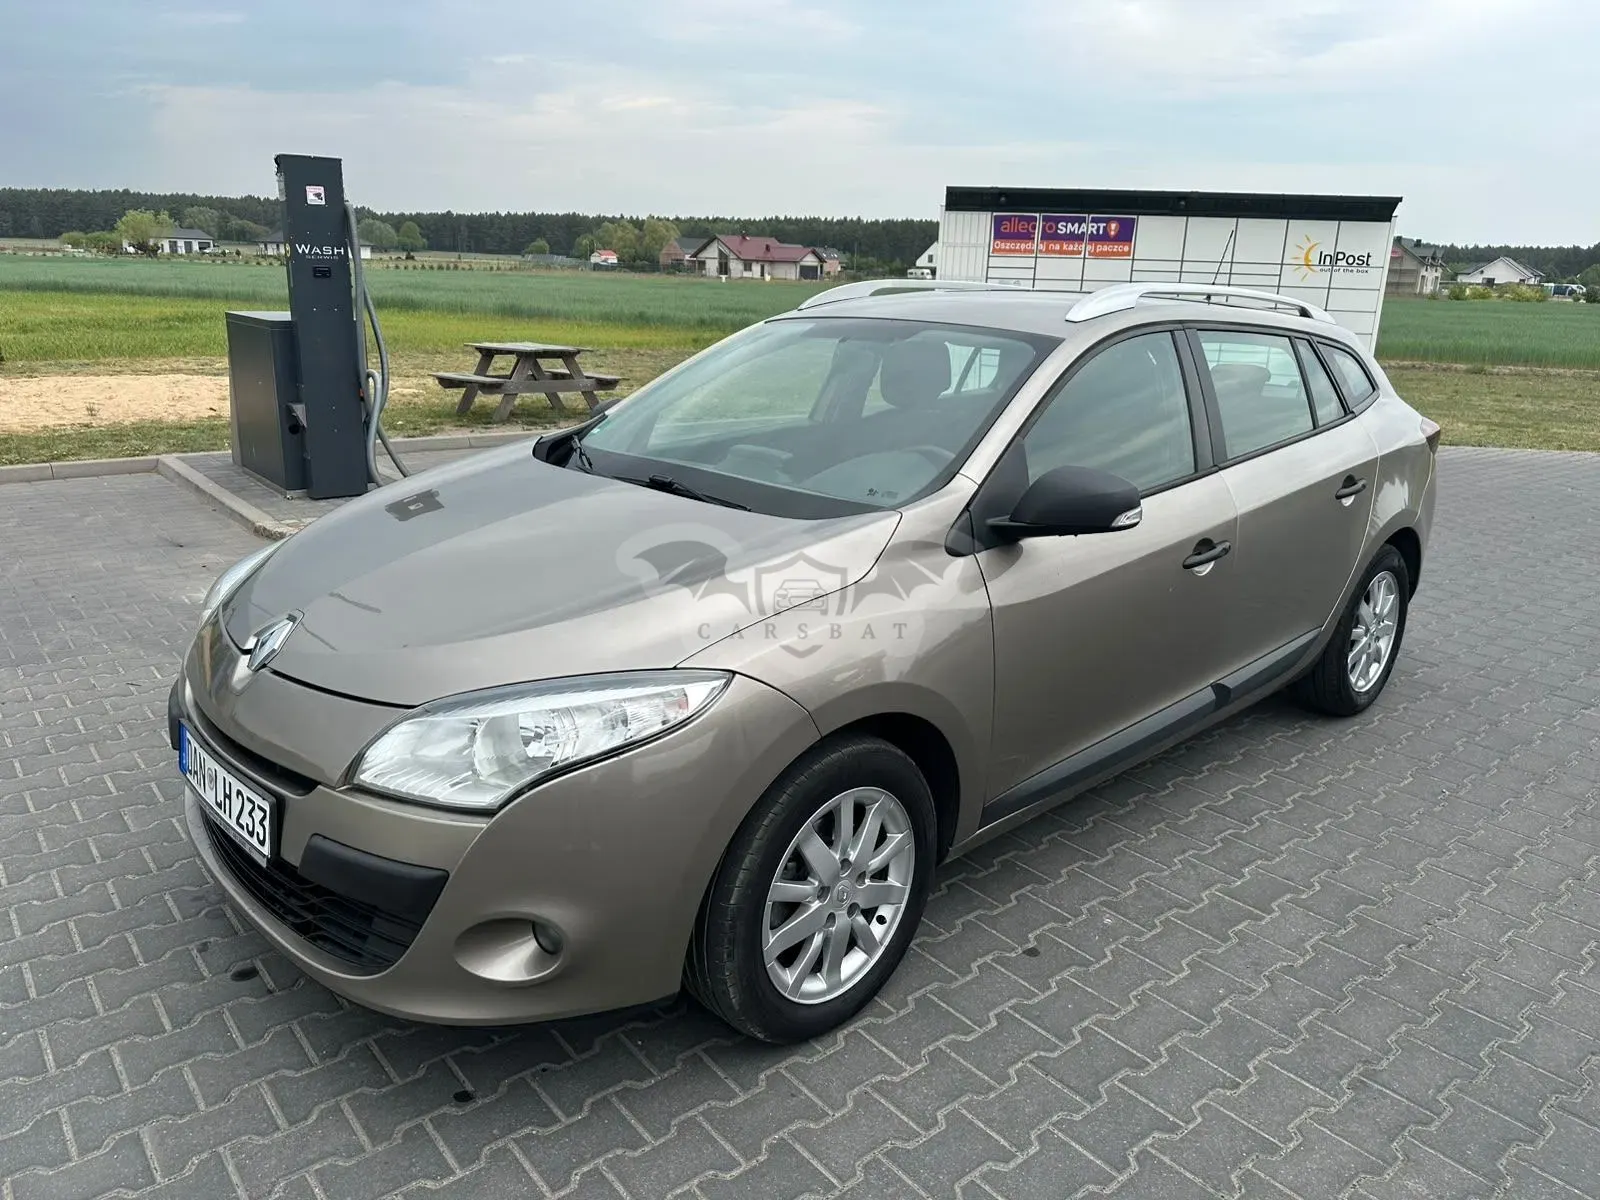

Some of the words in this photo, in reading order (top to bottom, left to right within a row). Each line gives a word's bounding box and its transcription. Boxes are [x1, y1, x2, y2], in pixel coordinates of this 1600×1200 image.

[1057, 221, 1106, 235] SMART
[295, 243, 344, 255] WASH
[1048, 243, 1060, 251] na
[1096, 244, 1129, 252] paczce
[1318, 251, 1372, 266] InPost
[186, 738, 207, 794] DAN
[214, 767, 232, 820] LH
[235, 788, 268, 847] 233
